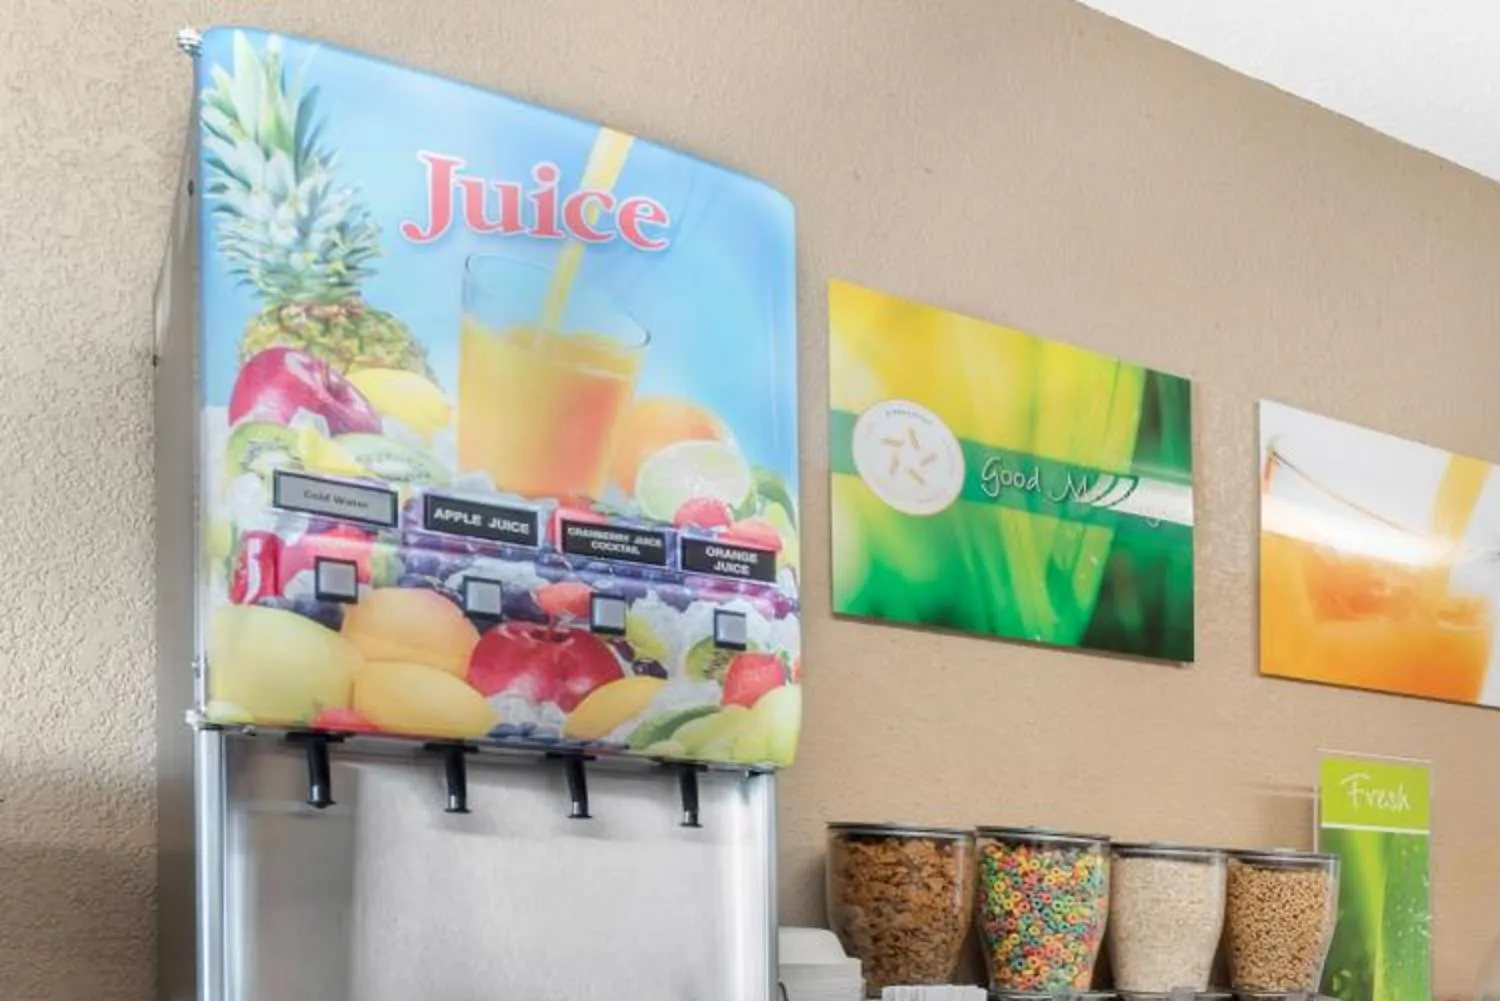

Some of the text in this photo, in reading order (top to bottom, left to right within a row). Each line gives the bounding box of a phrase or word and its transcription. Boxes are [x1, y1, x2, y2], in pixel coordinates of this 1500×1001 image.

[399, 149, 671, 252] Juice
[980, 456, 1041, 497] Good
[302, 488, 330, 503] Cold
[433, 507, 530, 536] APPLE JUICE
[567, 526, 663, 548] CRANBERRY JUICE
[590, 540, 641, 556] COCKTAIL
[705, 545, 758, 564] ORANGE
[713, 561, 750, 576] JUICE
[1340, 772, 1410, 812] Fresh
